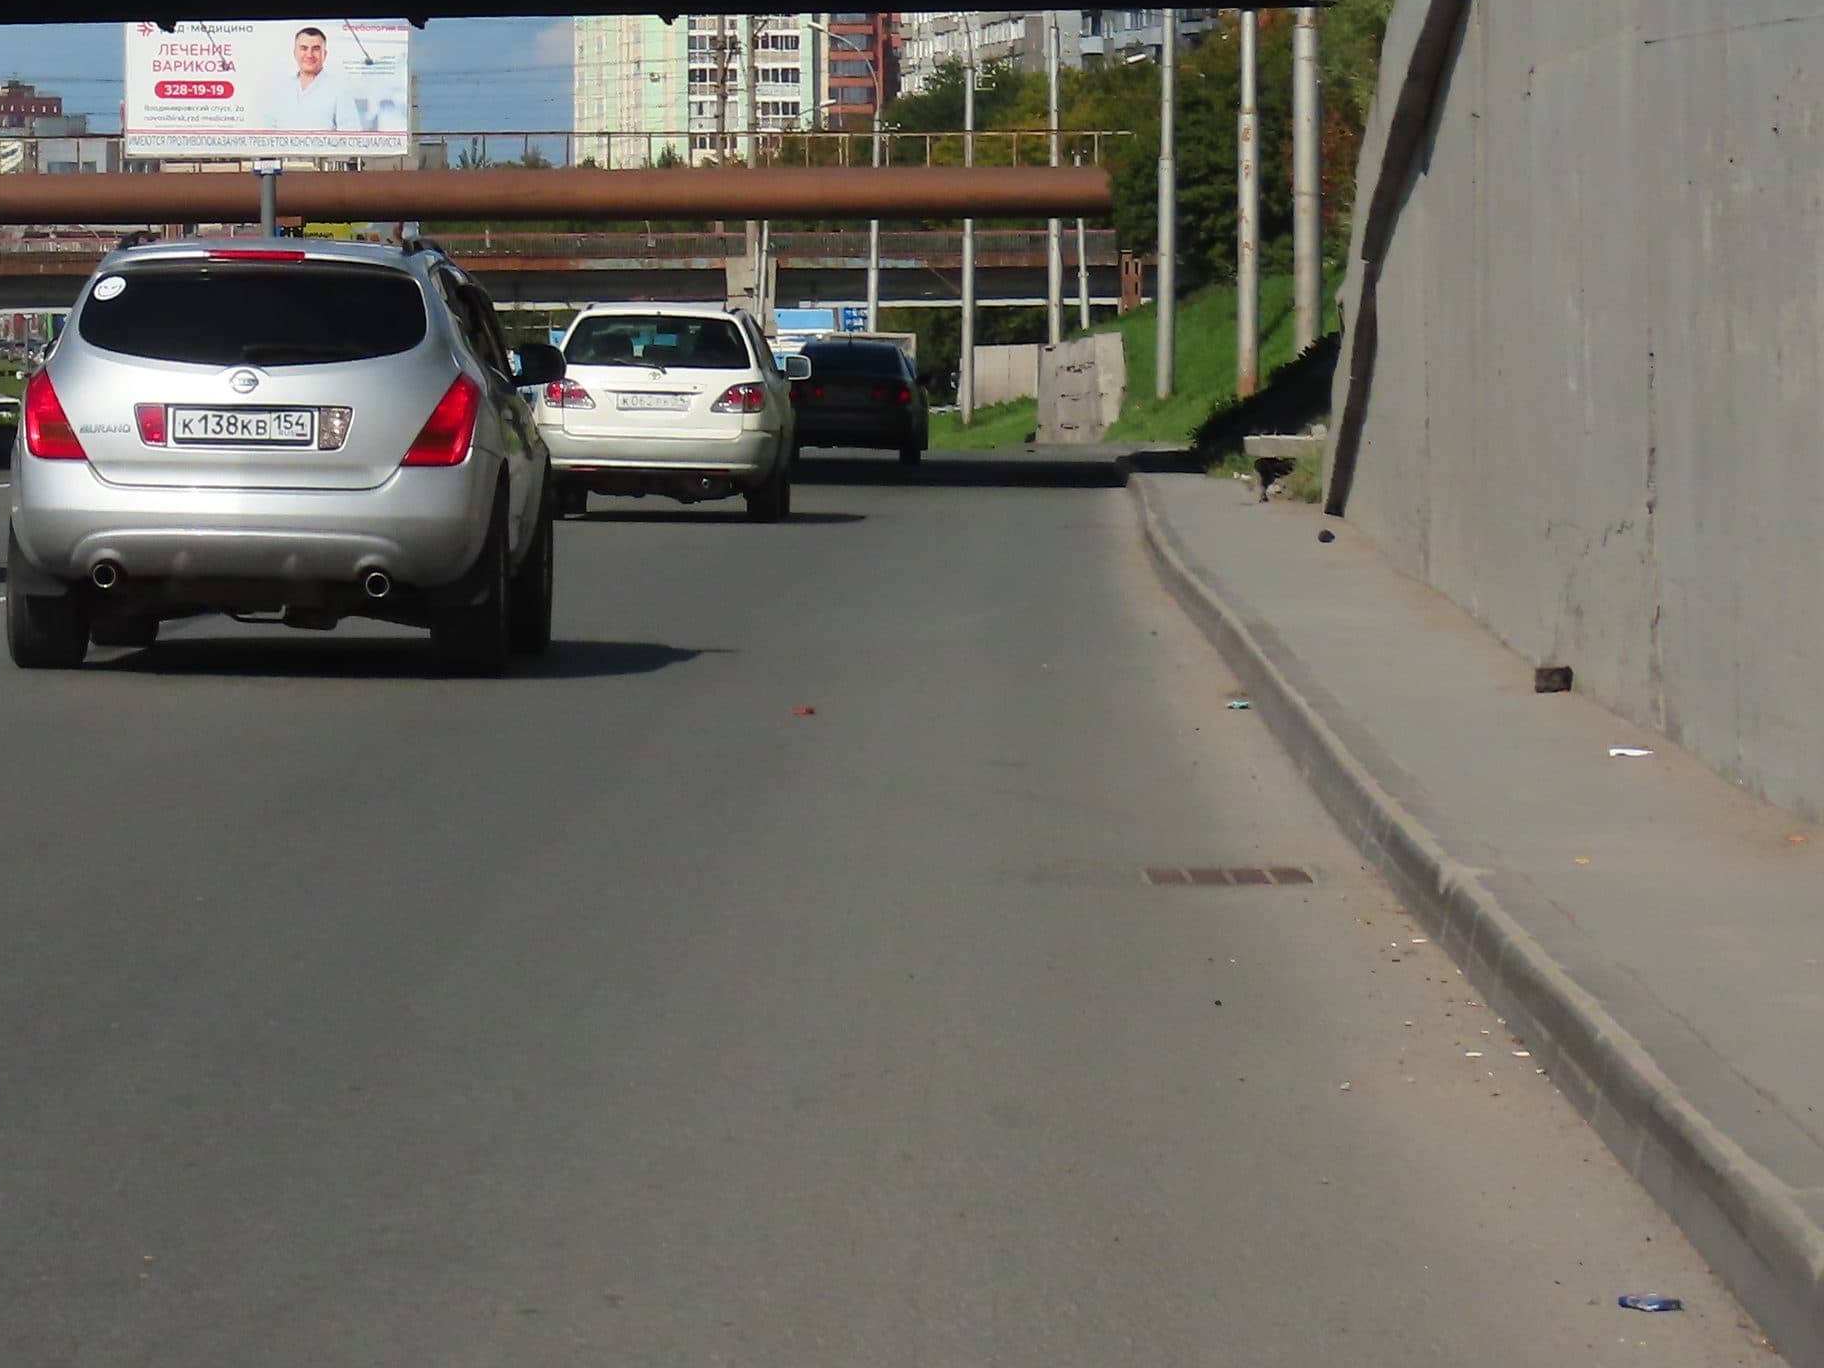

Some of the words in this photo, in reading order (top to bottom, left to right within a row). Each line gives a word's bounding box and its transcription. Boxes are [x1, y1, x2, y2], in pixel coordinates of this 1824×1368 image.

[158, 43, 232, 56] ЛЕЧЕНИЕ
[152, 60, 236, 72] ВАРИКОЗА
[164, 85, 225, 95] 328-19-19
[274, 415, 305, 430] 154
